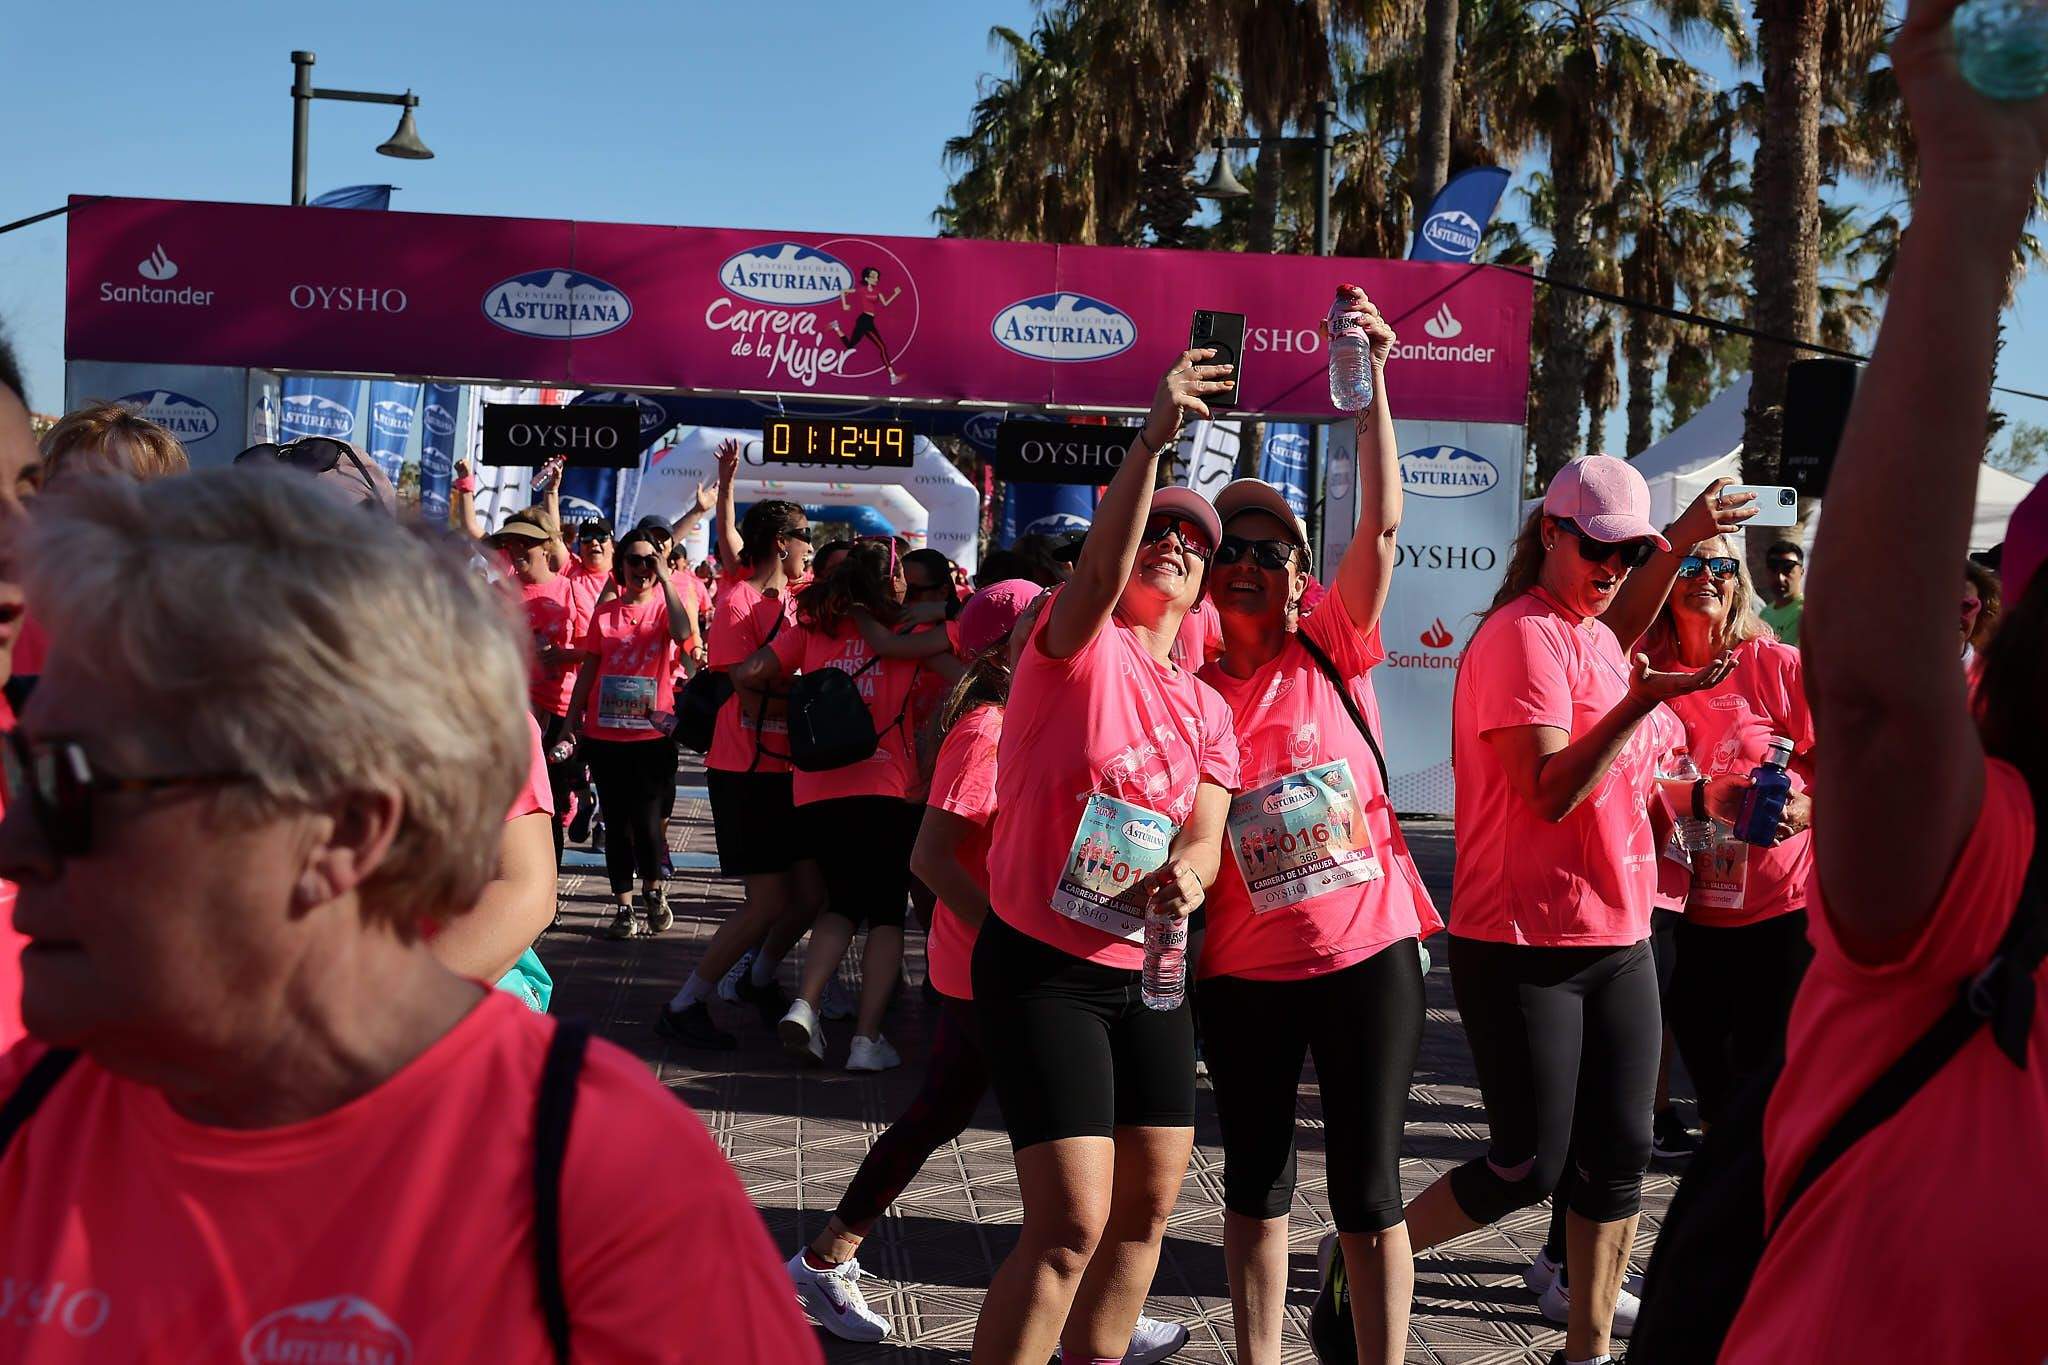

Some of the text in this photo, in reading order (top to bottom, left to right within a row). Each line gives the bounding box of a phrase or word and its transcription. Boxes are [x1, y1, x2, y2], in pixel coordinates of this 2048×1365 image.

[730, 264, 843, 291] ASTURIANA
[100, 282, 214, 305] Santander
[290, 284, 407, 313] OYSHO
[494, 292, 620, 321] ASTURIANA
[705, 298, 817, 335] Carrera
[1003, 316, 1125, 345] ASTURIANA
[1244, 328, 1319, 354] SHO
[731, 333, 856, 387] de la Mujer
[1389, 341, 1495, 363] Santander
[508, 424, 619, 449] OYSHO
[773, 424, 902, 457] 01:12:49
[1021, 441, 1127, 467] OYSHO
[1400, 464, 1490, 485] ASTURIANA
[1387, 651, 1464, 669] Santand
[1266, 791, 1315, 812] ASTURIANA
[1280, 823, 1329, 852] 016
[1300, 851, 1318, 863] 368
[1112, 862, 1153, 884] 01
[1254, 859, 1334, 890] CARRERA DE LA MUJER
[1065, 883, 1098, 902] CARRERA
[1266, 883, 1307, 903] OYSHO
[1066, 900, 1109, 922] OYSHO
